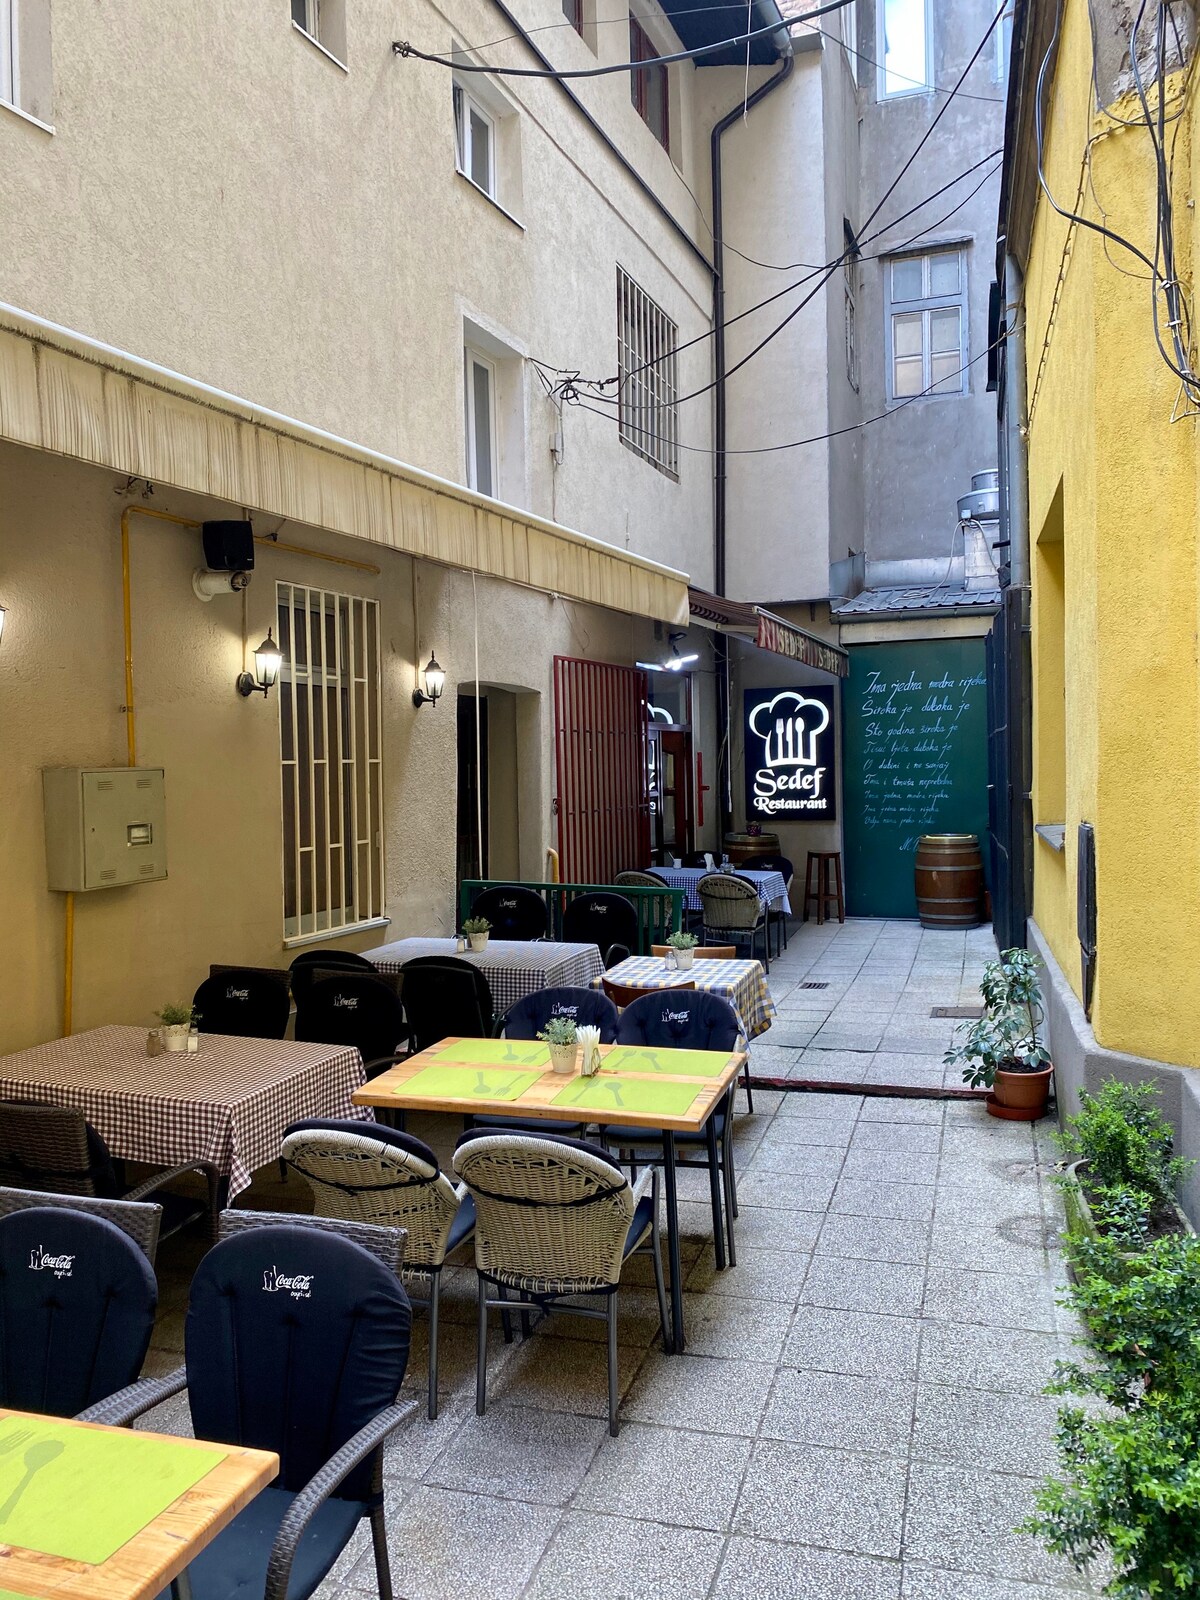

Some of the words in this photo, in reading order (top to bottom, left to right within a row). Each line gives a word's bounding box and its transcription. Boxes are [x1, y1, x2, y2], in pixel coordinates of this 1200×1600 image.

[779, 626, 805, 661] SEDEF
[862, 671, 886, 694] Ima
[886, 671, 922, 704] jedna
[959, 671, 987, 697] rijeka
[861, 695, 896, 717] Široka
[897, 703, 912, 723] je
[921, 695, 953, 712] duboka
[955, 700, 970, 721] je
[865, 721, 883, 738] Sto
[884, 721, 915, 743] godina
[920, 716, 946, 734] široka
[944, 723, 959, 740] je
[913, 739, 939, 752] duboka
[938, 742, 953, 761] je
[863, 758, 873, 771] O
[753, 767, 827, 798] Sedef
[754, 797, 827, 814] Restaurant
